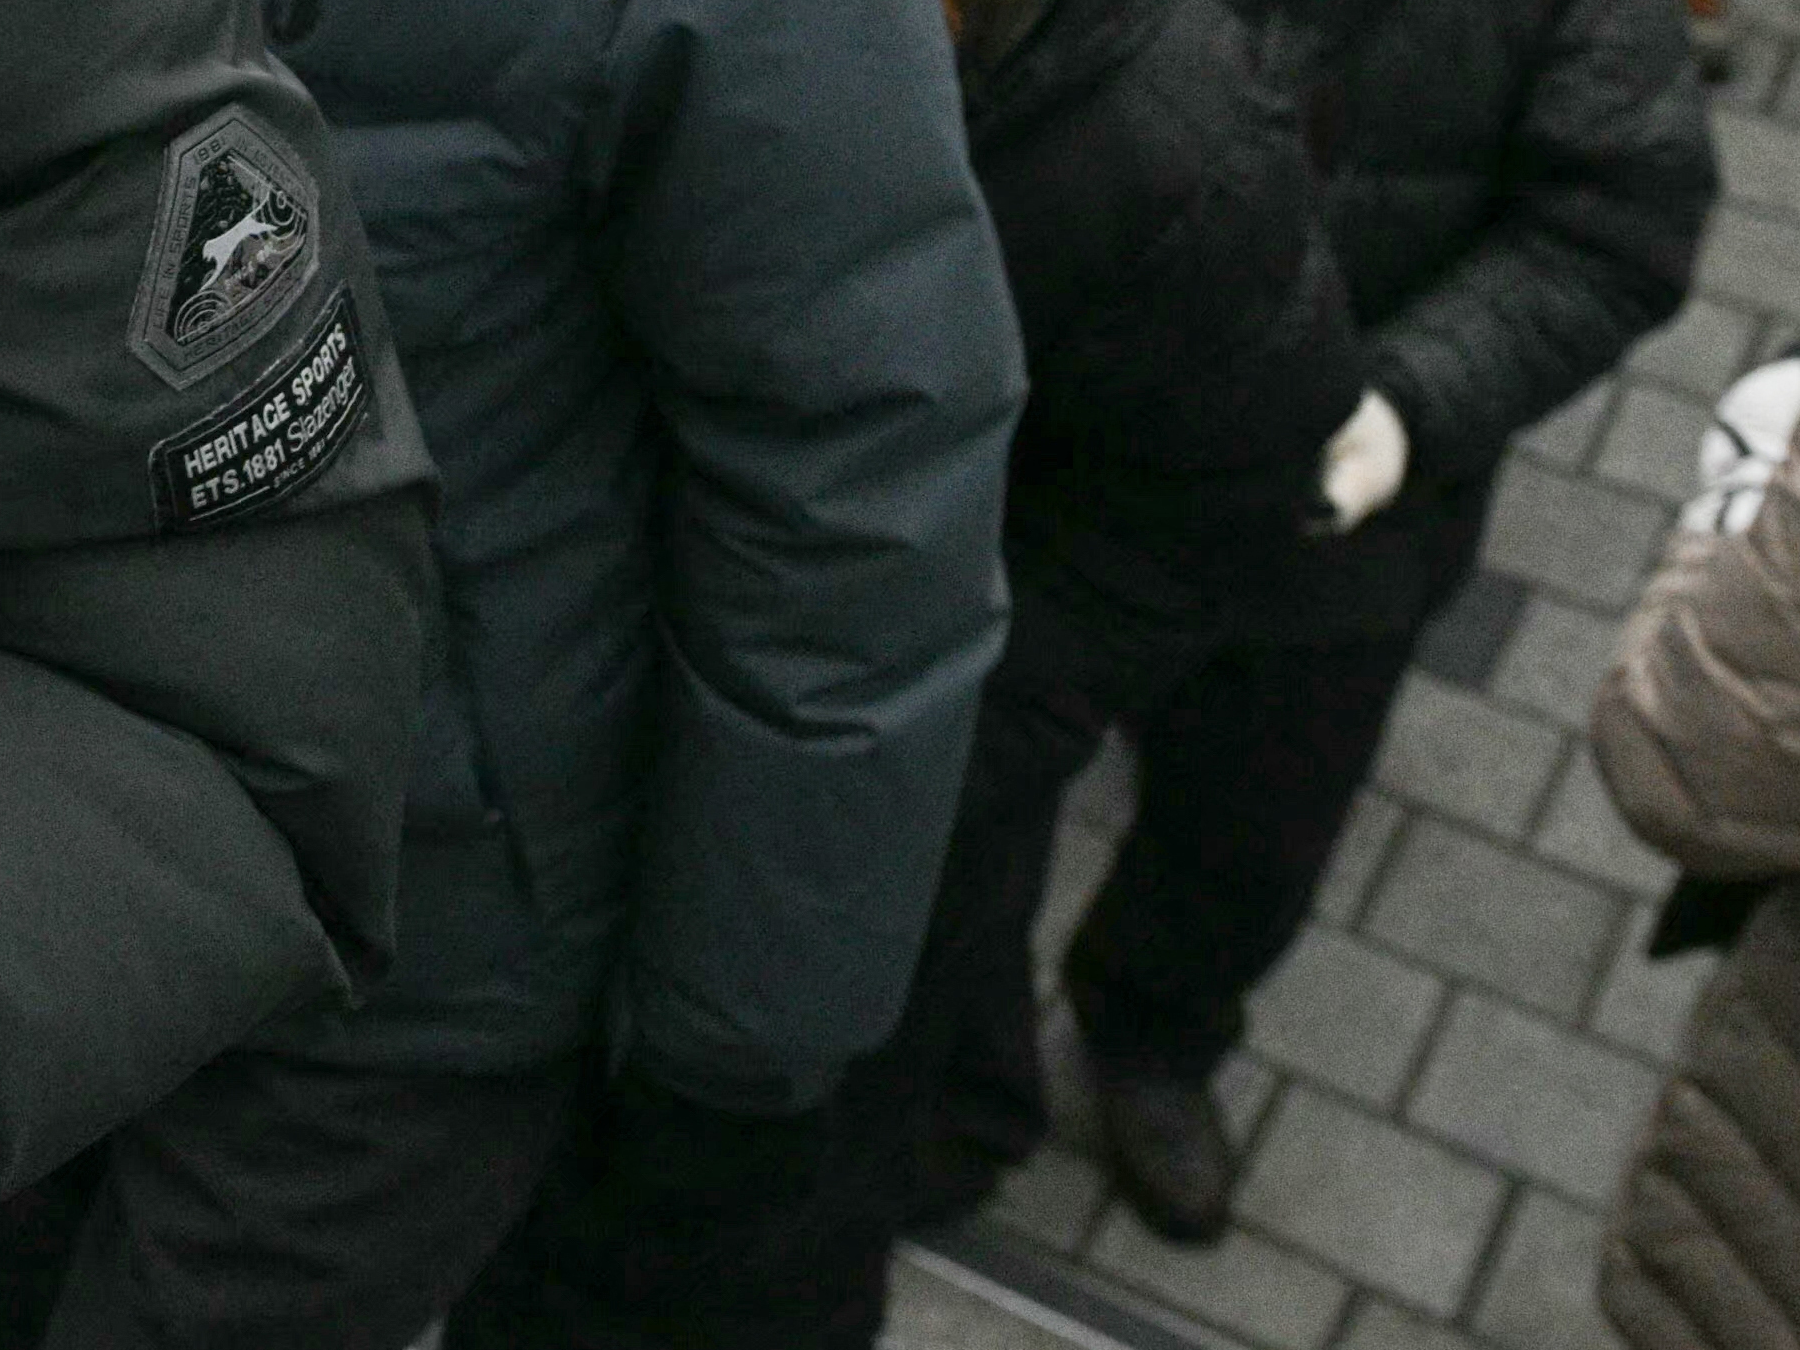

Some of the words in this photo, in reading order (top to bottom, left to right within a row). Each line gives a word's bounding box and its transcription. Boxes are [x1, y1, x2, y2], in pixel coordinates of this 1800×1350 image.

[183, 392, 292, 478] HERITAGE
[291, 322, 347, 406] SPORTS
[287, 356, 356, 453] Slazenger
